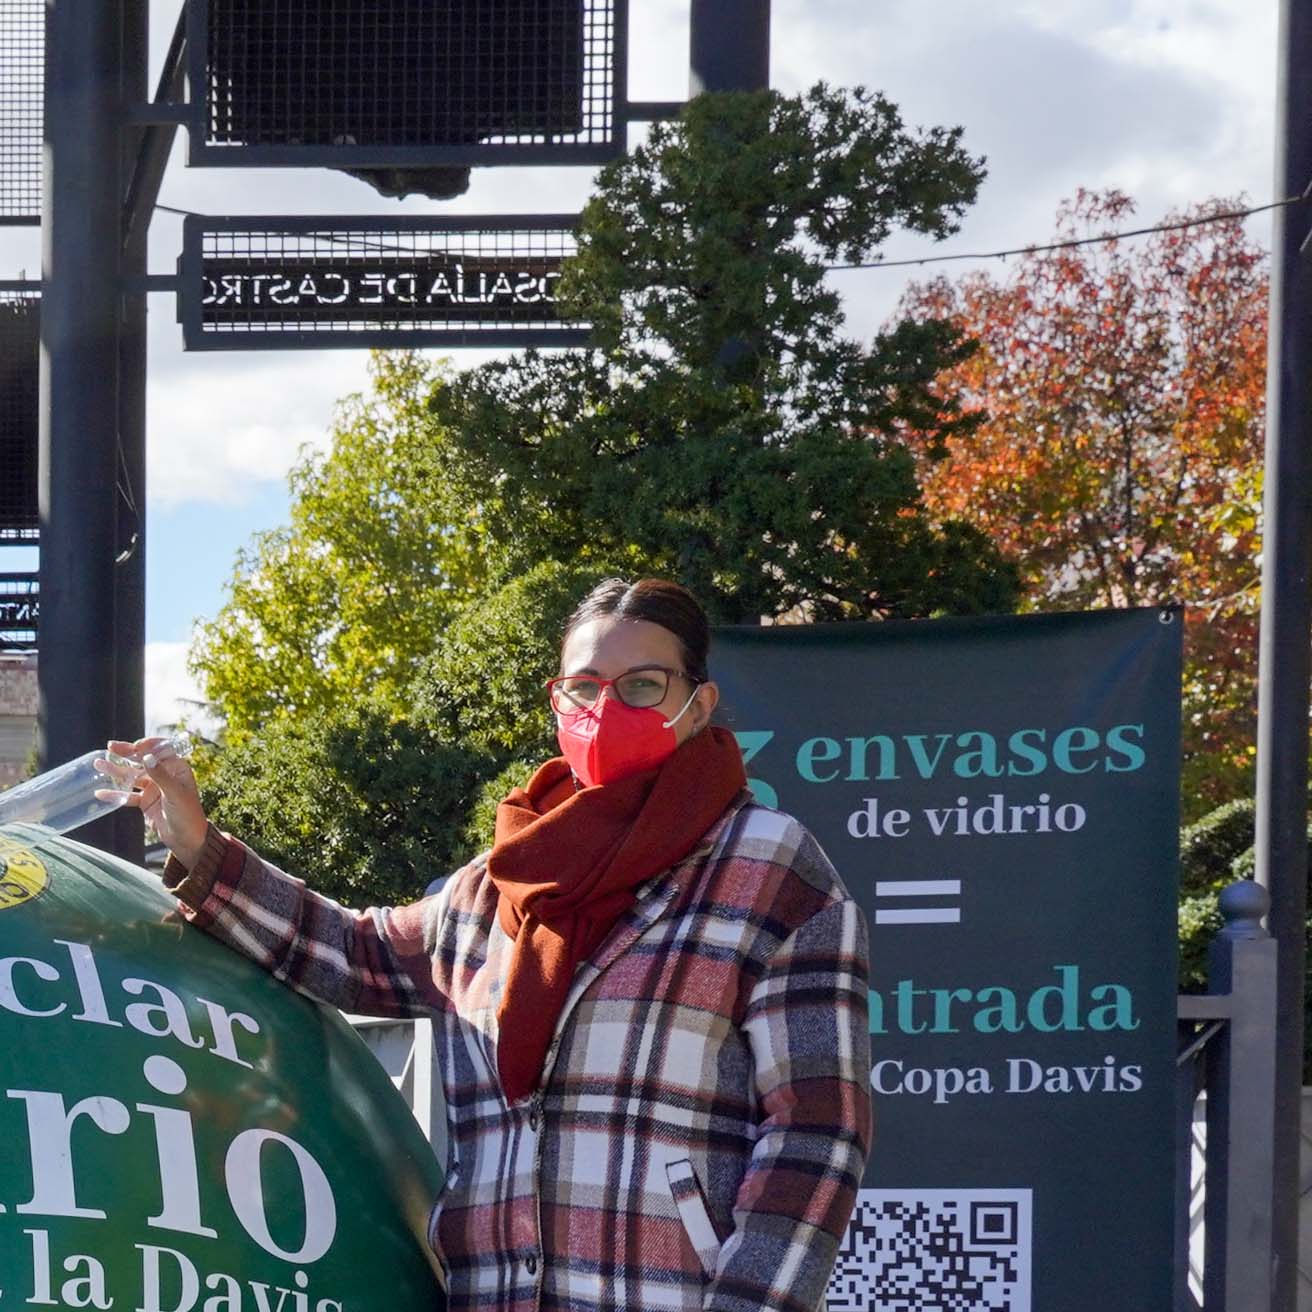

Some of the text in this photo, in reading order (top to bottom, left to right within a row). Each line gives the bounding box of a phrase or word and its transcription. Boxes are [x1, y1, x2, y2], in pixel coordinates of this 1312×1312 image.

[795, 723, 1146, 783] envases
[847, 793, 1087, 838] de vidrio
[867, 966, 1140, 1035] ntrada
[870, 1056, 1143, 1104] Copa Davis
[24, 1229, 113, 1310] la
